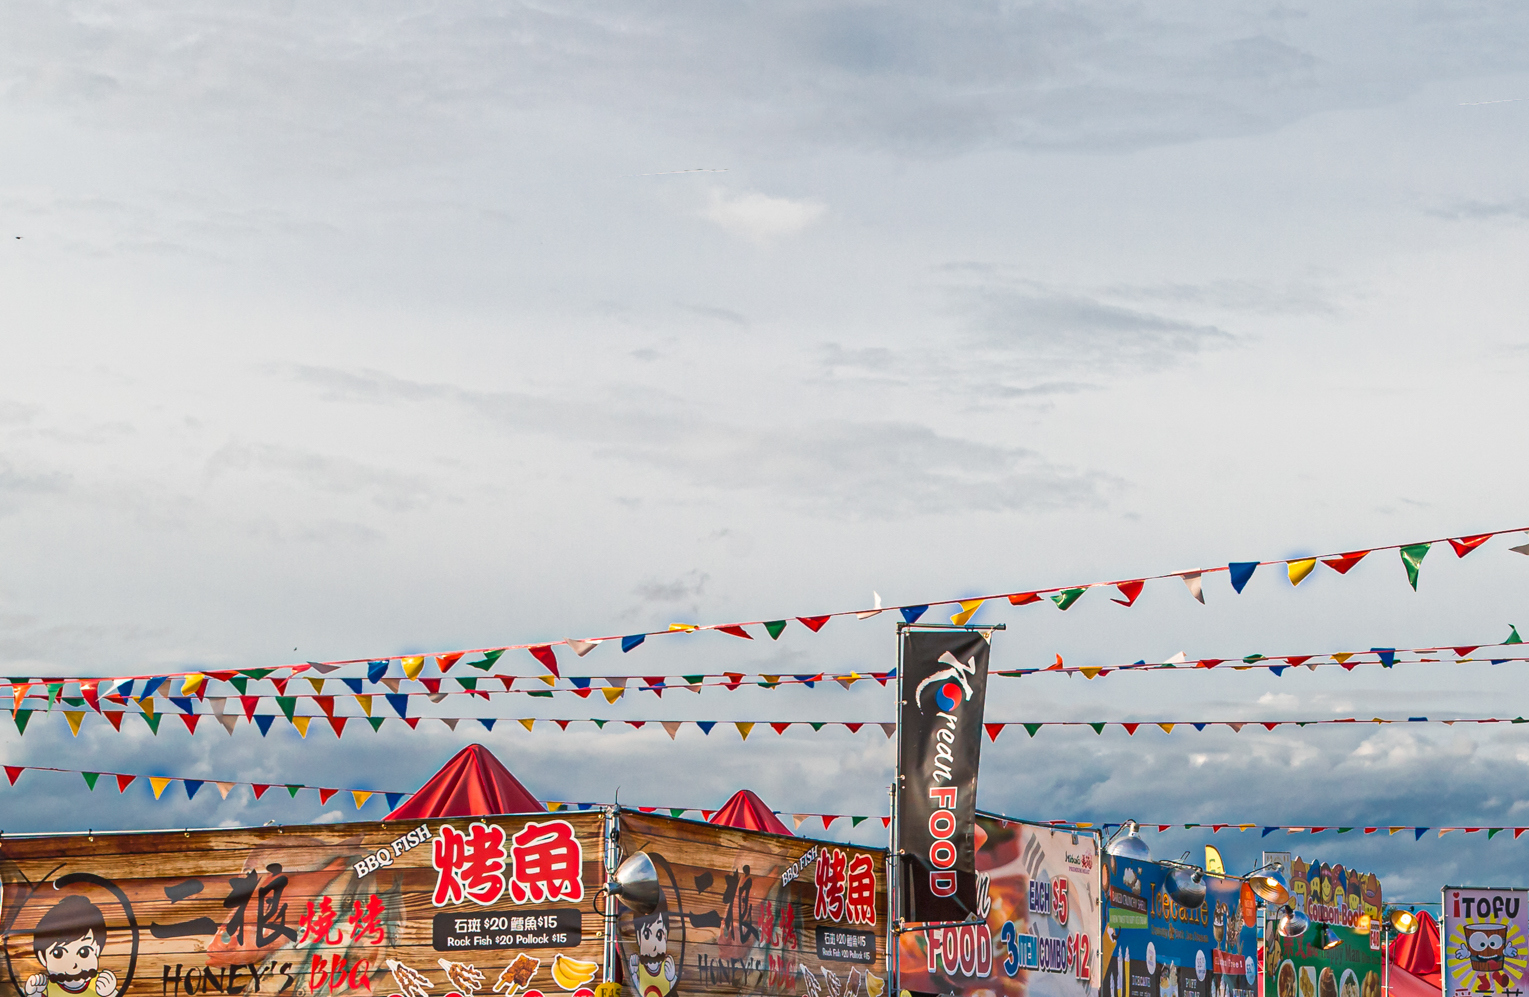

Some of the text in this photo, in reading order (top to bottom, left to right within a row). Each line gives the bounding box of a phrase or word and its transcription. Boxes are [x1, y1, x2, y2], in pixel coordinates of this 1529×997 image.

[354, 824, 433, 878] BBQ FISH
[432, 819, 584, 906] 烤魚
[782, 845, 818, 887] BBQ FISH
[929, 786, 958, 898] FOOD
[814, 847, 876, 926] 烤魚
[1029, 879, 1050, 914] EACH
[1052, 877, 1068, 925] $5
[1308, 897, 1339, 924] Coupon
[299, 894, 386, 946] 燒烤
[447, 934, 566, 947] Rock Fish $20 Pollock $15
[484, 917, 508, 931] $20
[538, 916, 558, 929] $15
[309, 953, 372, 994] BBQ
[698, 953, 762, 987] HONEY'S
[927, 921, 992, 978] FOOD
[1000, 920, 1090, 980] 3 ITEM COMBO $12
[1345, 944, 1360, 962] Man
